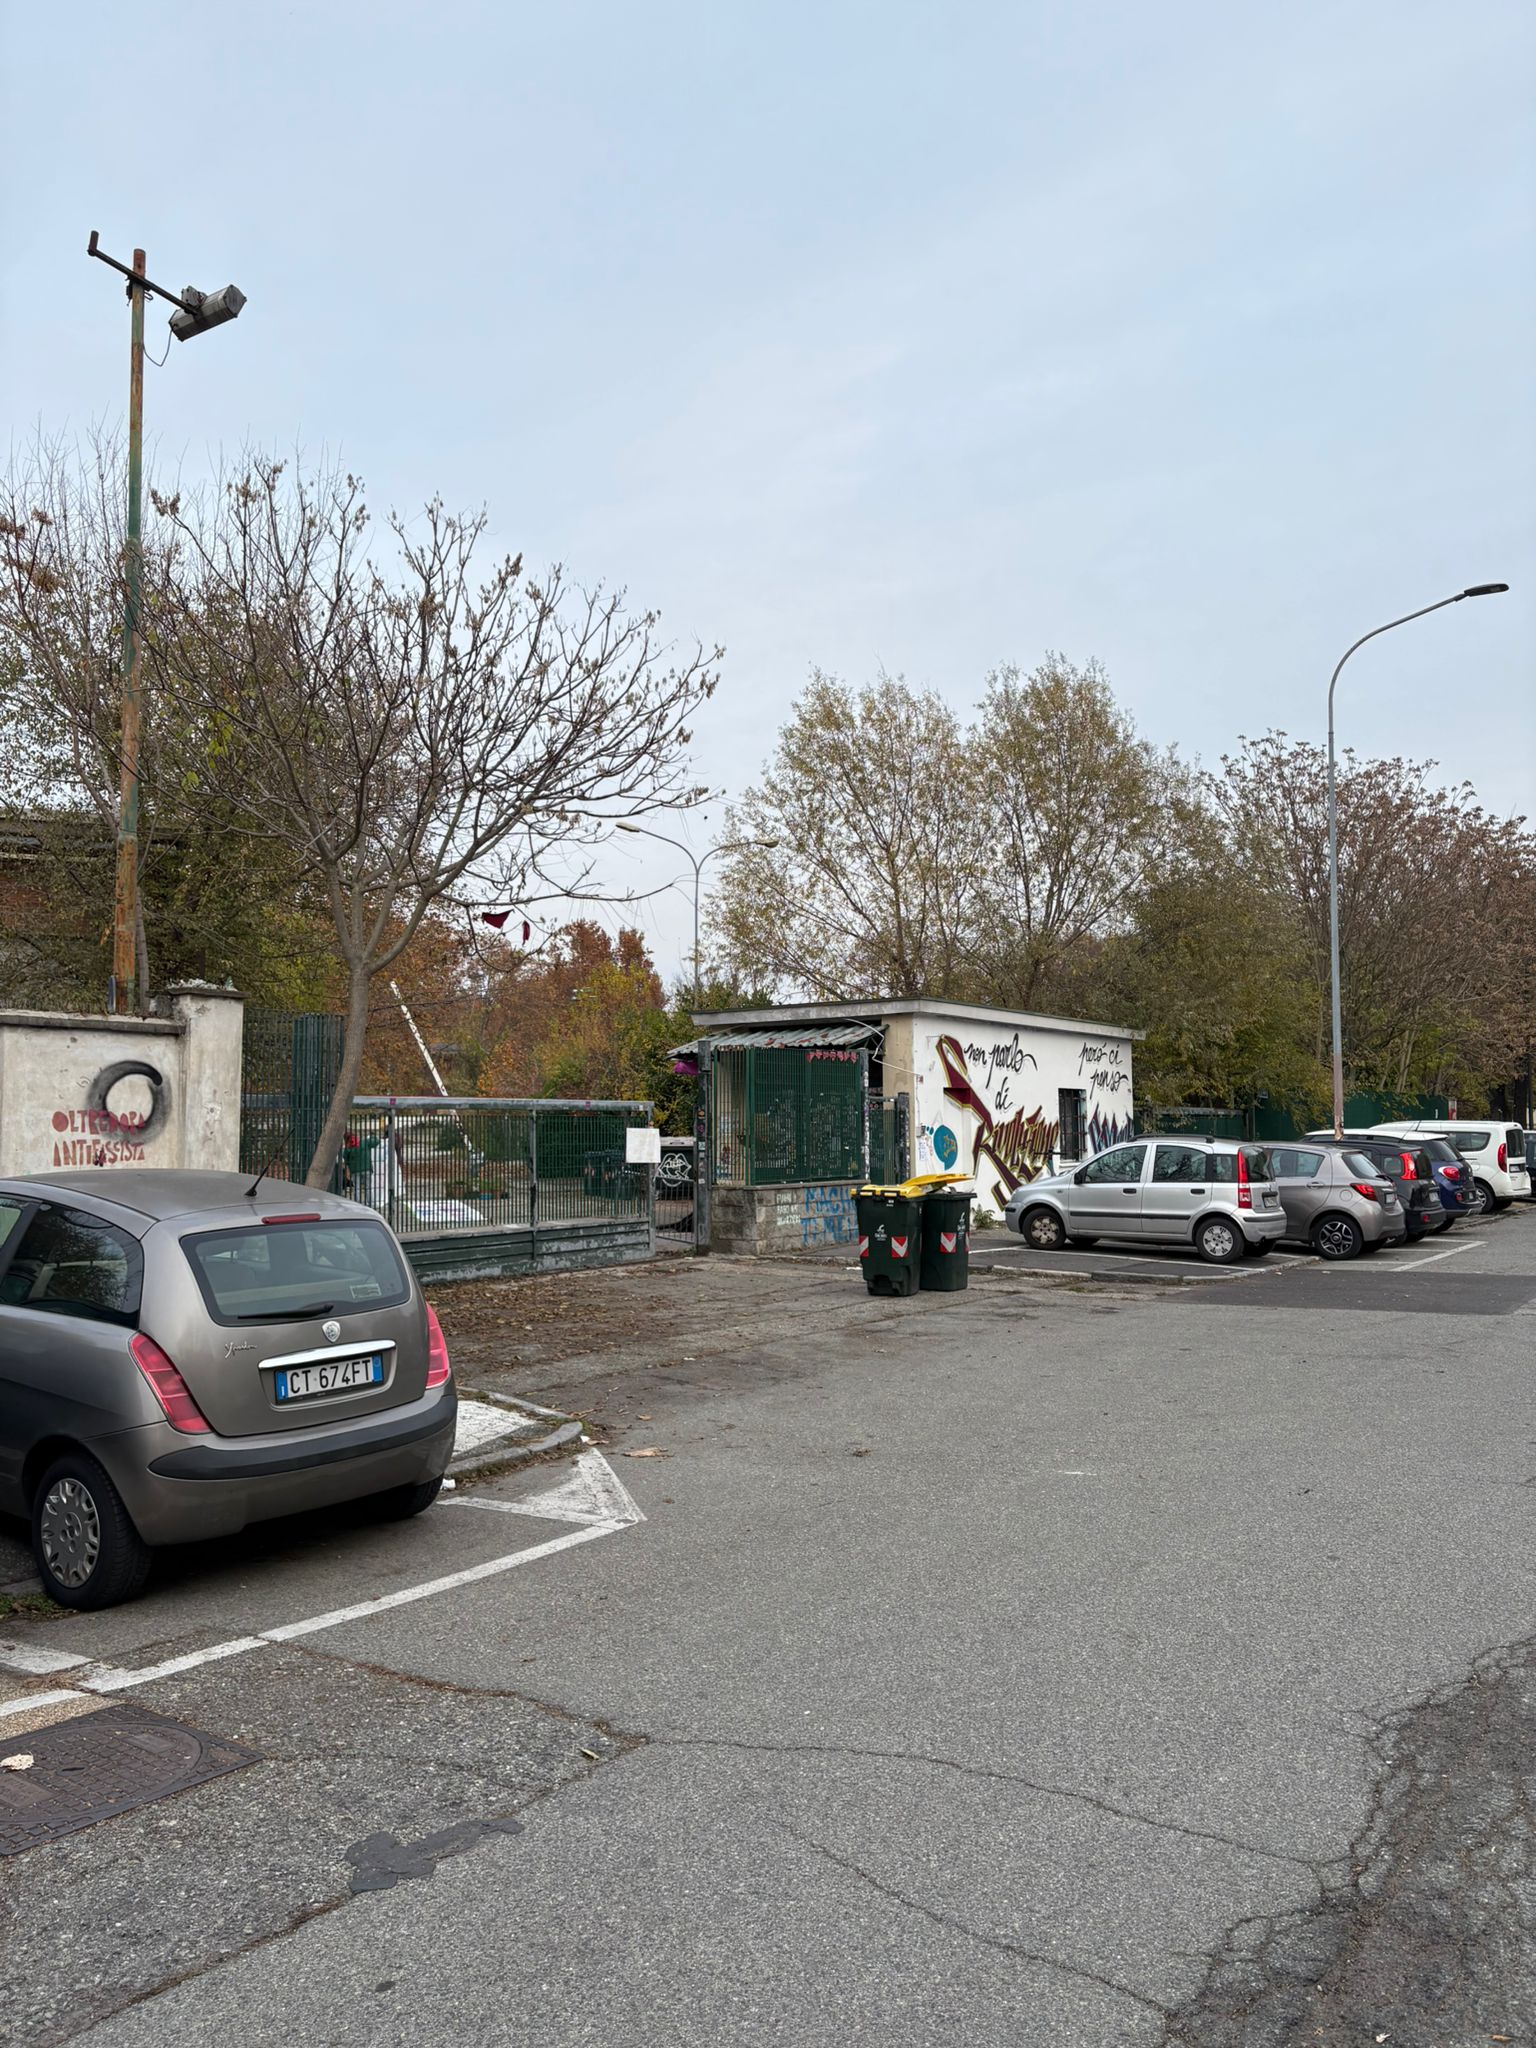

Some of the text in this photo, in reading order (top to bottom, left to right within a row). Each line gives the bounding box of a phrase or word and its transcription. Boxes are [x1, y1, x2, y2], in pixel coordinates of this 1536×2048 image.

[964, 1033, 1038, 1089] non parlo
[1109, 1044, 1123, 1065] ci
[995, 1076, 1013, 1110] di
[1090, 1069, 1129, 1100] penso
[290, 1369, 311, 1394] CT
[319, 1360, 371, 1389] 674FT
